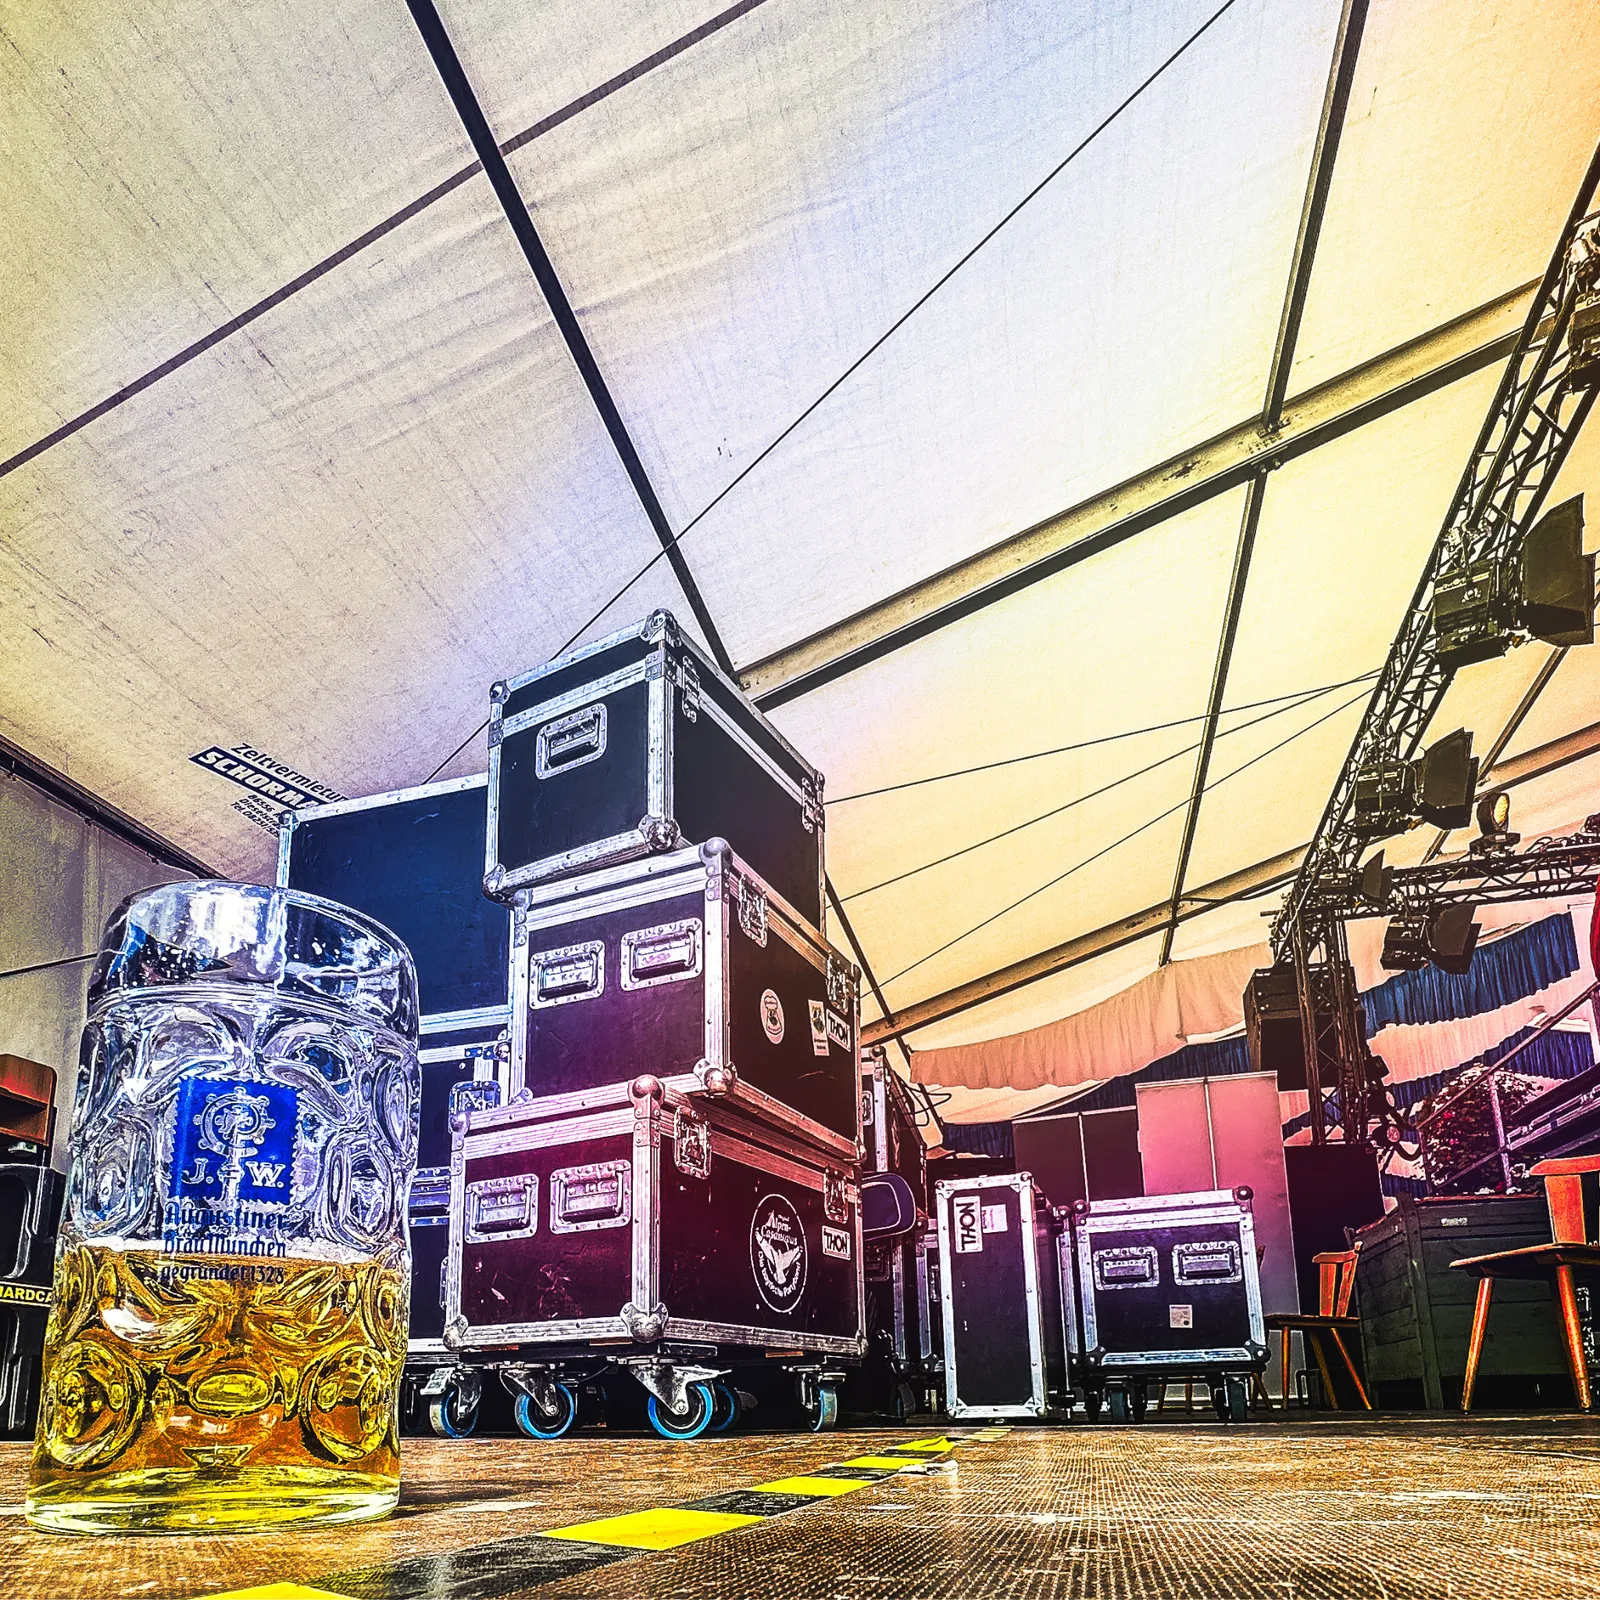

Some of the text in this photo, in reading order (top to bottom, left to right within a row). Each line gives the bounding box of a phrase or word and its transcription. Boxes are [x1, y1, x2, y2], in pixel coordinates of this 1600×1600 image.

[164, 1201, 288, 1230] Augustiner
[956, 1202, 977, 1252] THON
[824, 1231, 848, 1254] THON
[249, 1265, 284, 1285] 1328
